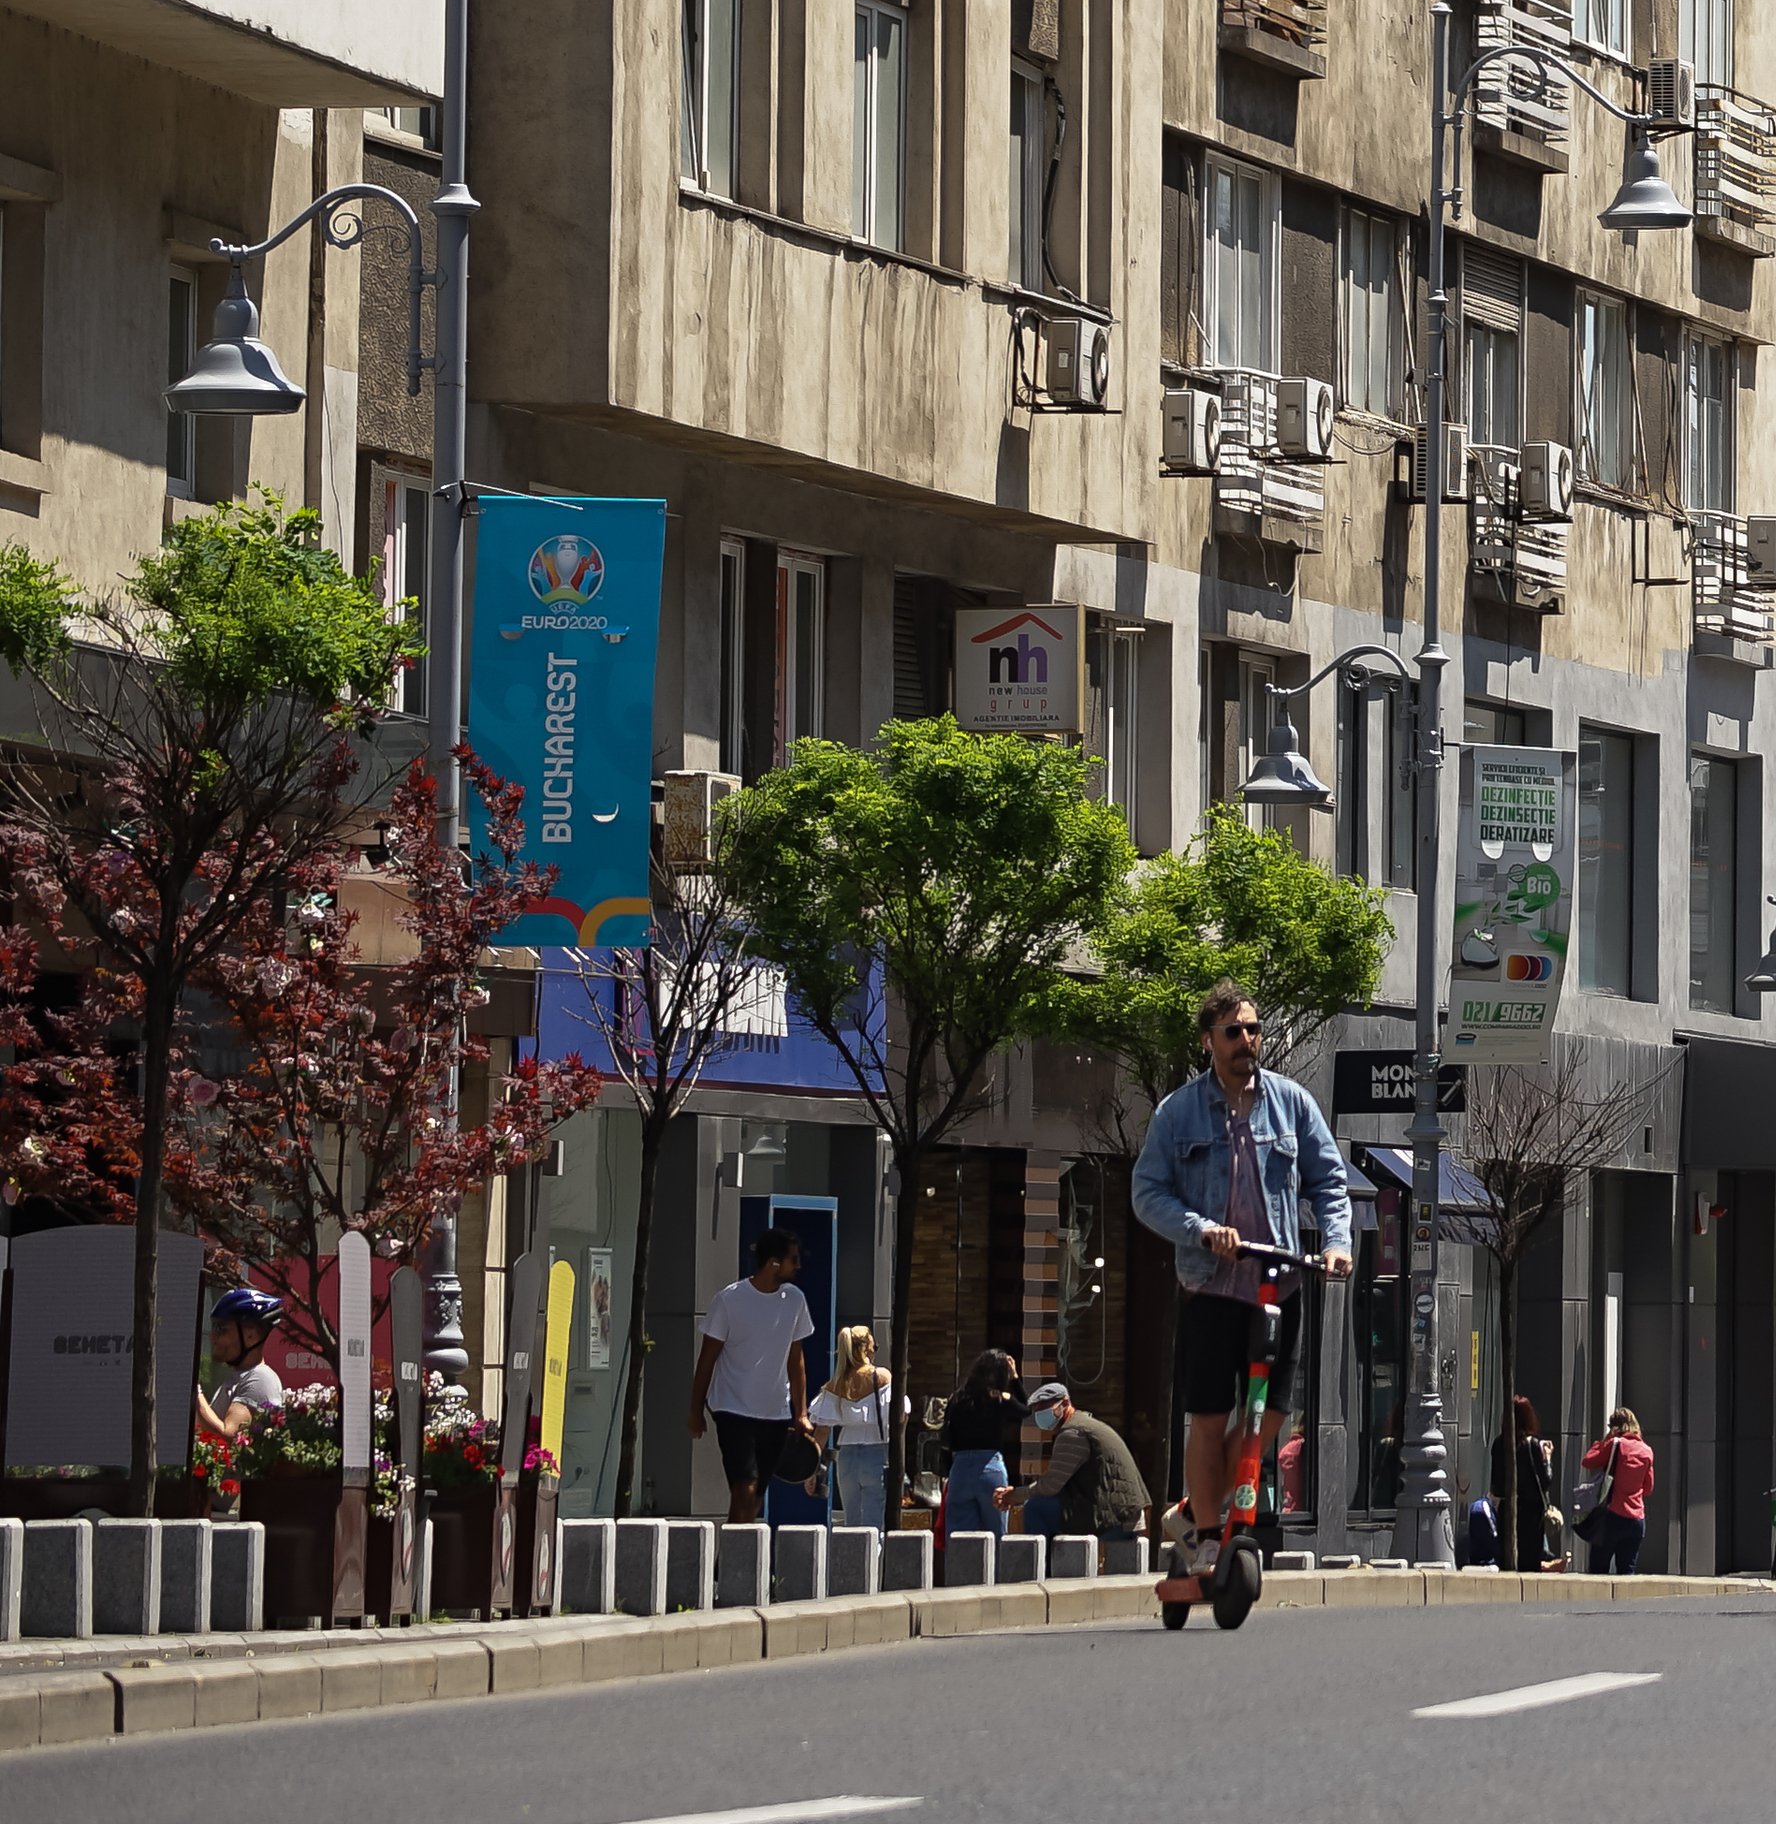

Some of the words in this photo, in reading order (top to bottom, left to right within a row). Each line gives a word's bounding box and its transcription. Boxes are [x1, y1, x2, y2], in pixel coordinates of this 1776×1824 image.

[551, 603, 578, 614] UEFA
[521, 616, 608, 629] EURO2020
[988, 686, 1013, 695] new
[1017, 685, 1048, 695] house
[990, 699, 1047, 712] grup
[542, 652, 578, 843] BUCHAREST
[1480, 825, 1554, 843] DERATIZARE
[1371, 1064, 1417, 1082] MON
[1371, 1083, 1417, 1099] BLAN
